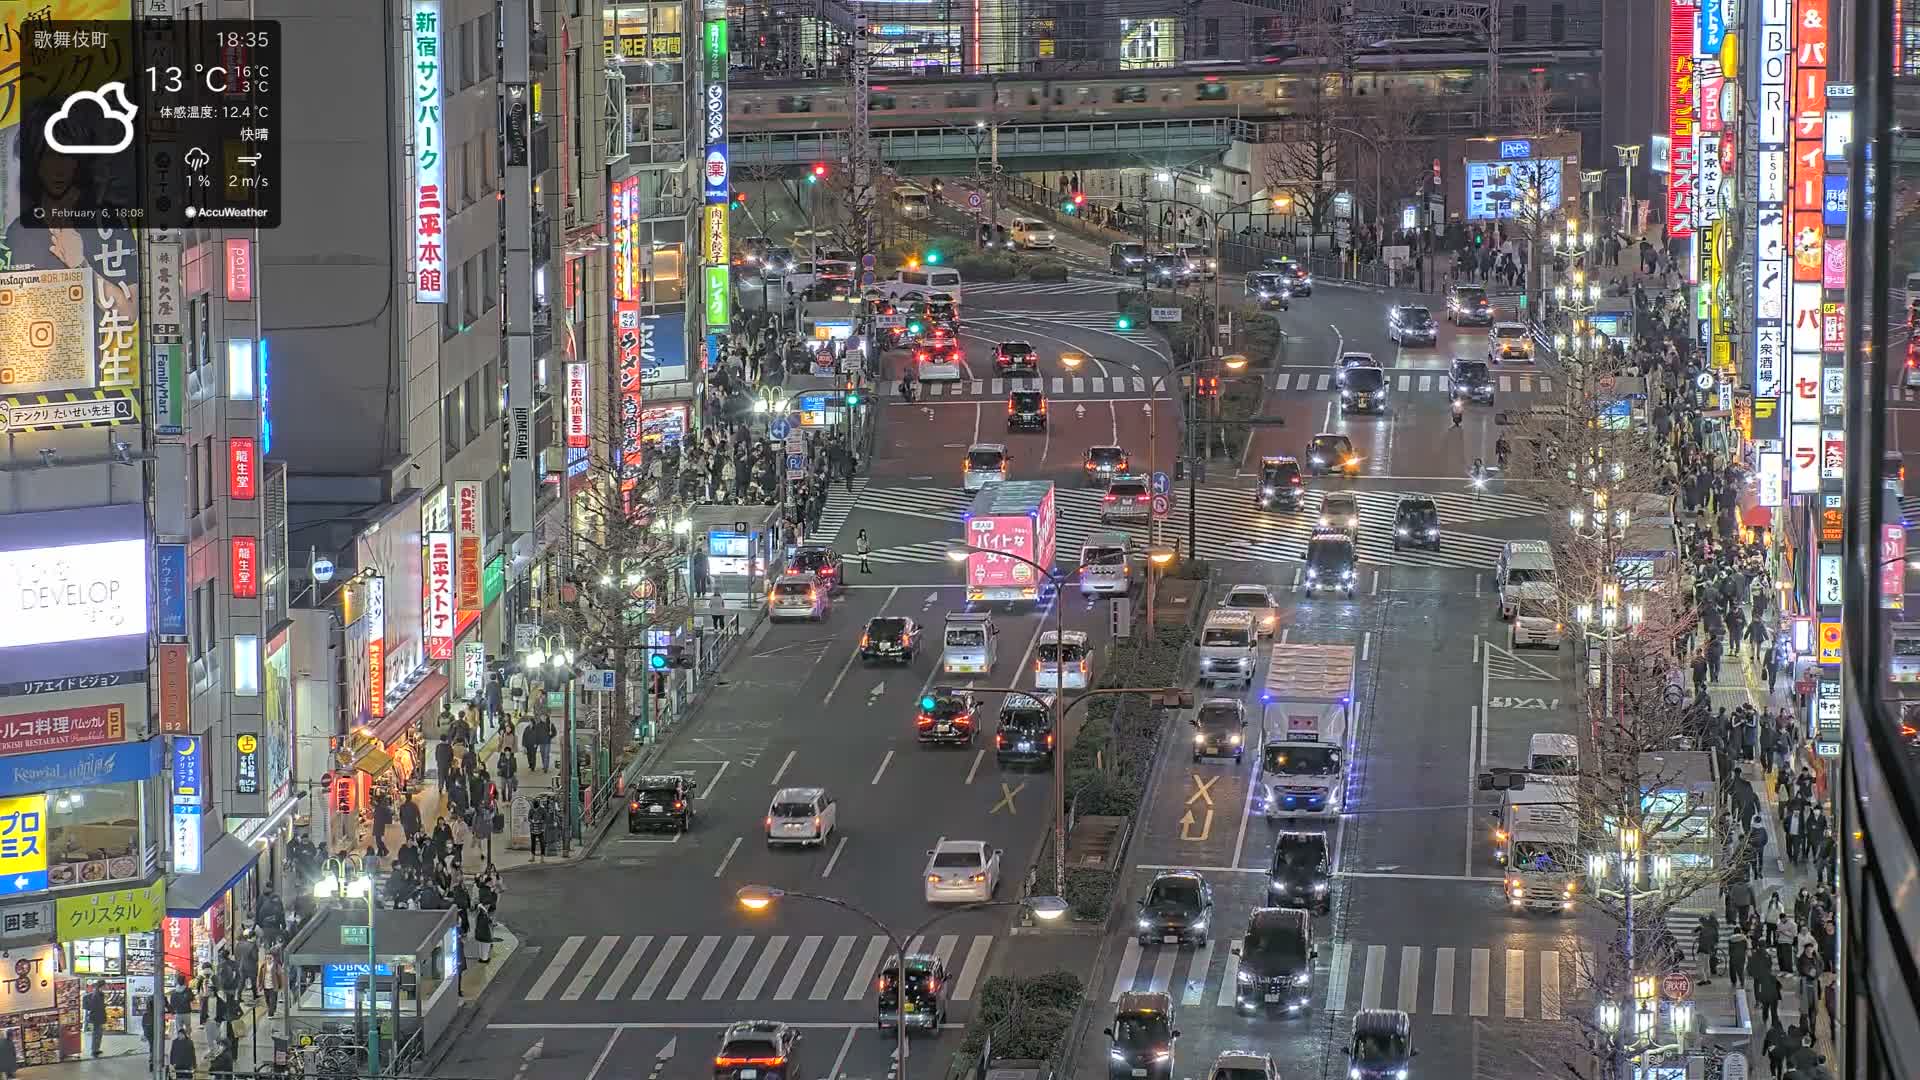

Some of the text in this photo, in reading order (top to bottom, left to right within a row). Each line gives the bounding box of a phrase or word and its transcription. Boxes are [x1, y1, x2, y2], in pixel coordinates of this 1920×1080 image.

[416, 12, 440, 170] 新宿サンパーク
[1705, 87, 1717, 121] アコム
[708, 160, 724, 177] 薬
[418, 184, 442, 292] 三平本館
[157, 267, 174, 316] 喜久屋
[711, 276, 723, 316] レイク
[1825, 304, 1834, 312] 6F
[158, 324, 176, 334] 3F
[620, 332, 637, 388] ラーメン
[1760, 330, 1773, 382] 大衆酒場
[157, 353, 170, 415] FamilyMart
[1795, 308, 1820, 469] パセラ
[13, 404, 112, 423] テンクリ たいせい先生
[1829, 405, 1841, 414] 5F
[516, 408, 527, 460] HOMEGAME
[461, 487, 472, 532] GAME
[1829, 497, 1840, 506] 3F
[978, 533, 1024, 547] バイトな
[22, 580, 120, 610] DEVELOP
[432, 542, 449, 630] 三平ストア
[432, 638, 443, 646] B1
[440, 649, 451, 657] B2
[24, 674, 119, 694] リアエイドビジョン
[0, 716, 69, 739] ルコ料理
[165, 722, 181, 731] B2
[25, 735, 69, 747] RESTAURANT
[242, 736, 253, 750] 占
[1, 812, 39, 836] プロ
[1, 836, 39, 858] ミス
[4, 911, 39, 932] 囲碁
[70, 902, 142, 928] クリスタル
[332, 964, 384, 972] SUBNAE
